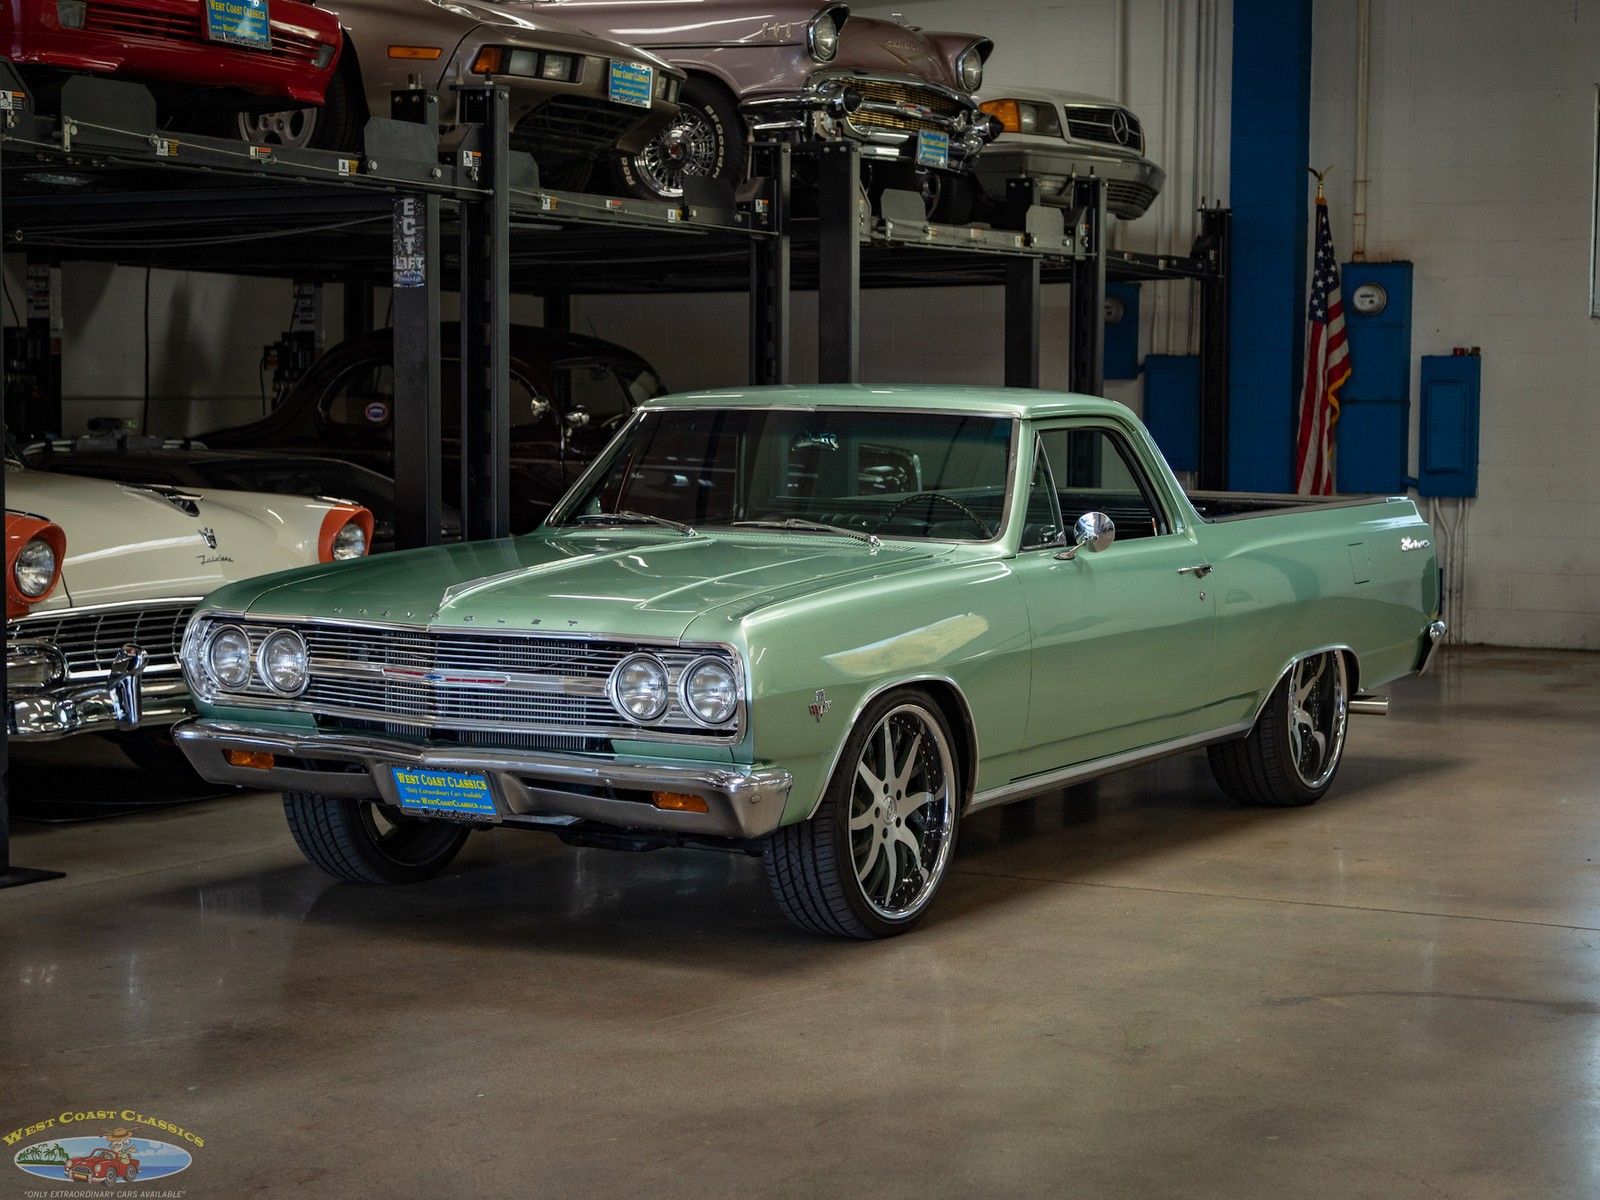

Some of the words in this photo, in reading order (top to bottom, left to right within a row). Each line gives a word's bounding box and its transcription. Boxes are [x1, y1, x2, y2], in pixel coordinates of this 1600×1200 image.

[396, 772, 420, 785] WEST
[420, 773, 447, 787] COAST
[447, 776, 487, 791] CLASSICS
